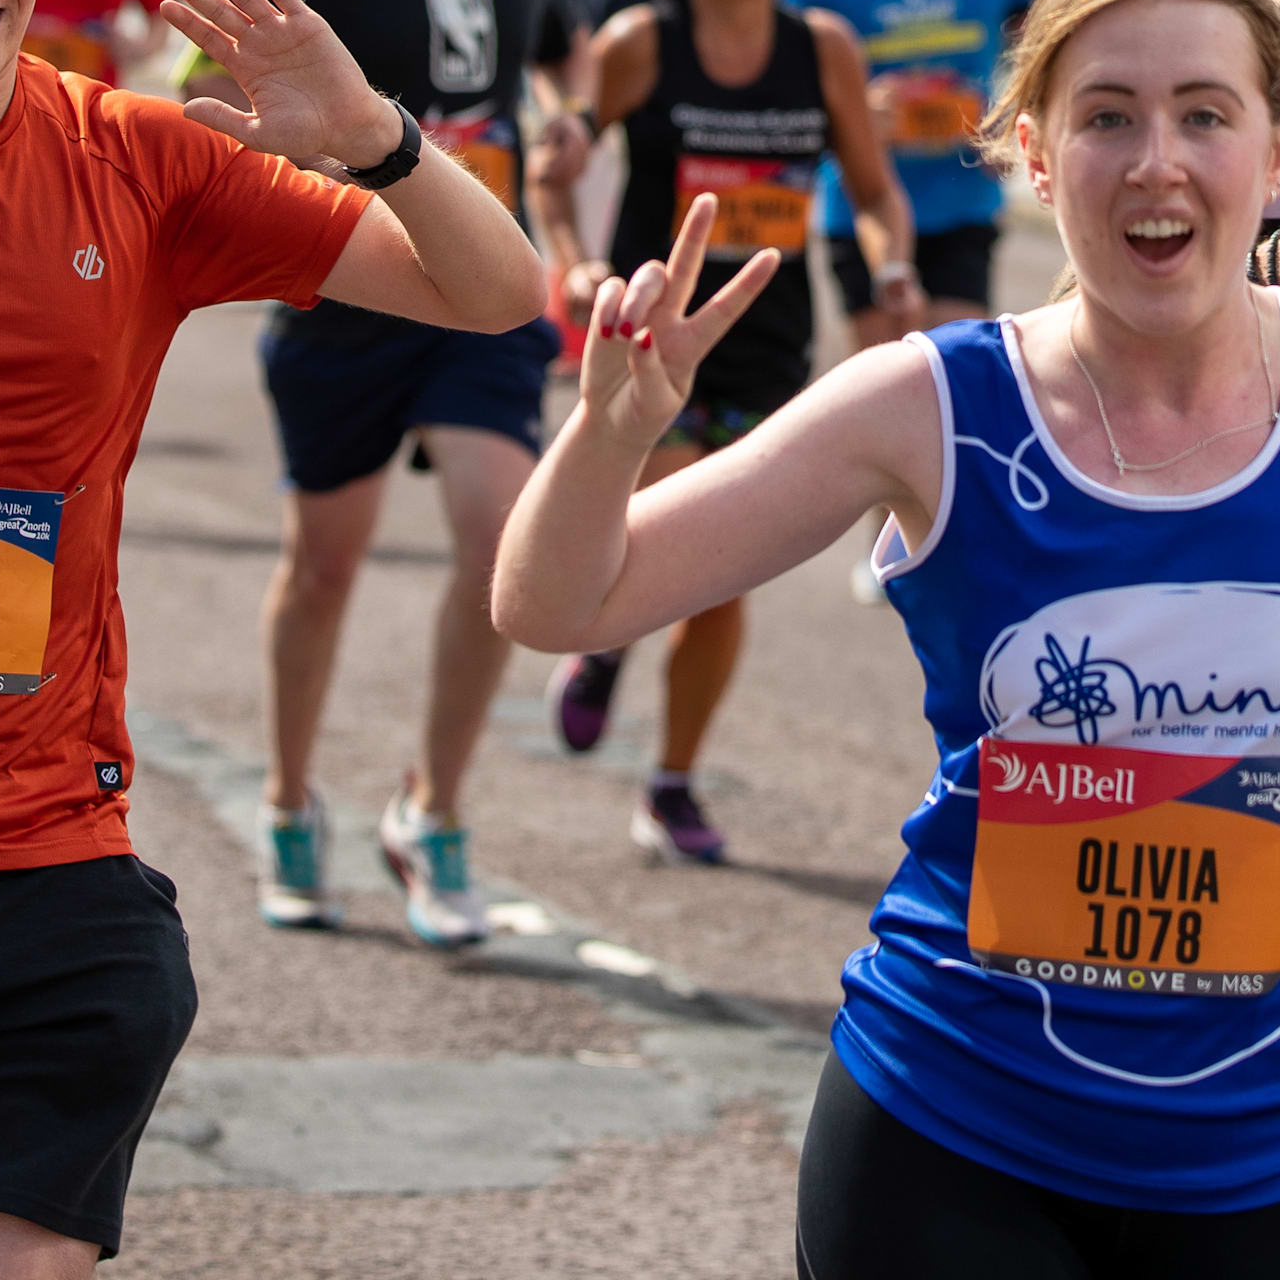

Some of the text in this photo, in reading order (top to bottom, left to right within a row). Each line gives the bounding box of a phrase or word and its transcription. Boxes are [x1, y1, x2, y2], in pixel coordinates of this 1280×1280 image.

[1, 502, 32, 516] AJBell
[27, 522, 50, 532] north
[1160, 723, 1209, 737] better
[1214, 723, 1268, 738] mental
[1025, 762, 1135, 805] AJBell
[1076, 838, 1219, 903] OLIVIA
[1084, 903, 1202, 965] 1078
[1015, 958, 1265, 994] GOODMOVE by M&S
